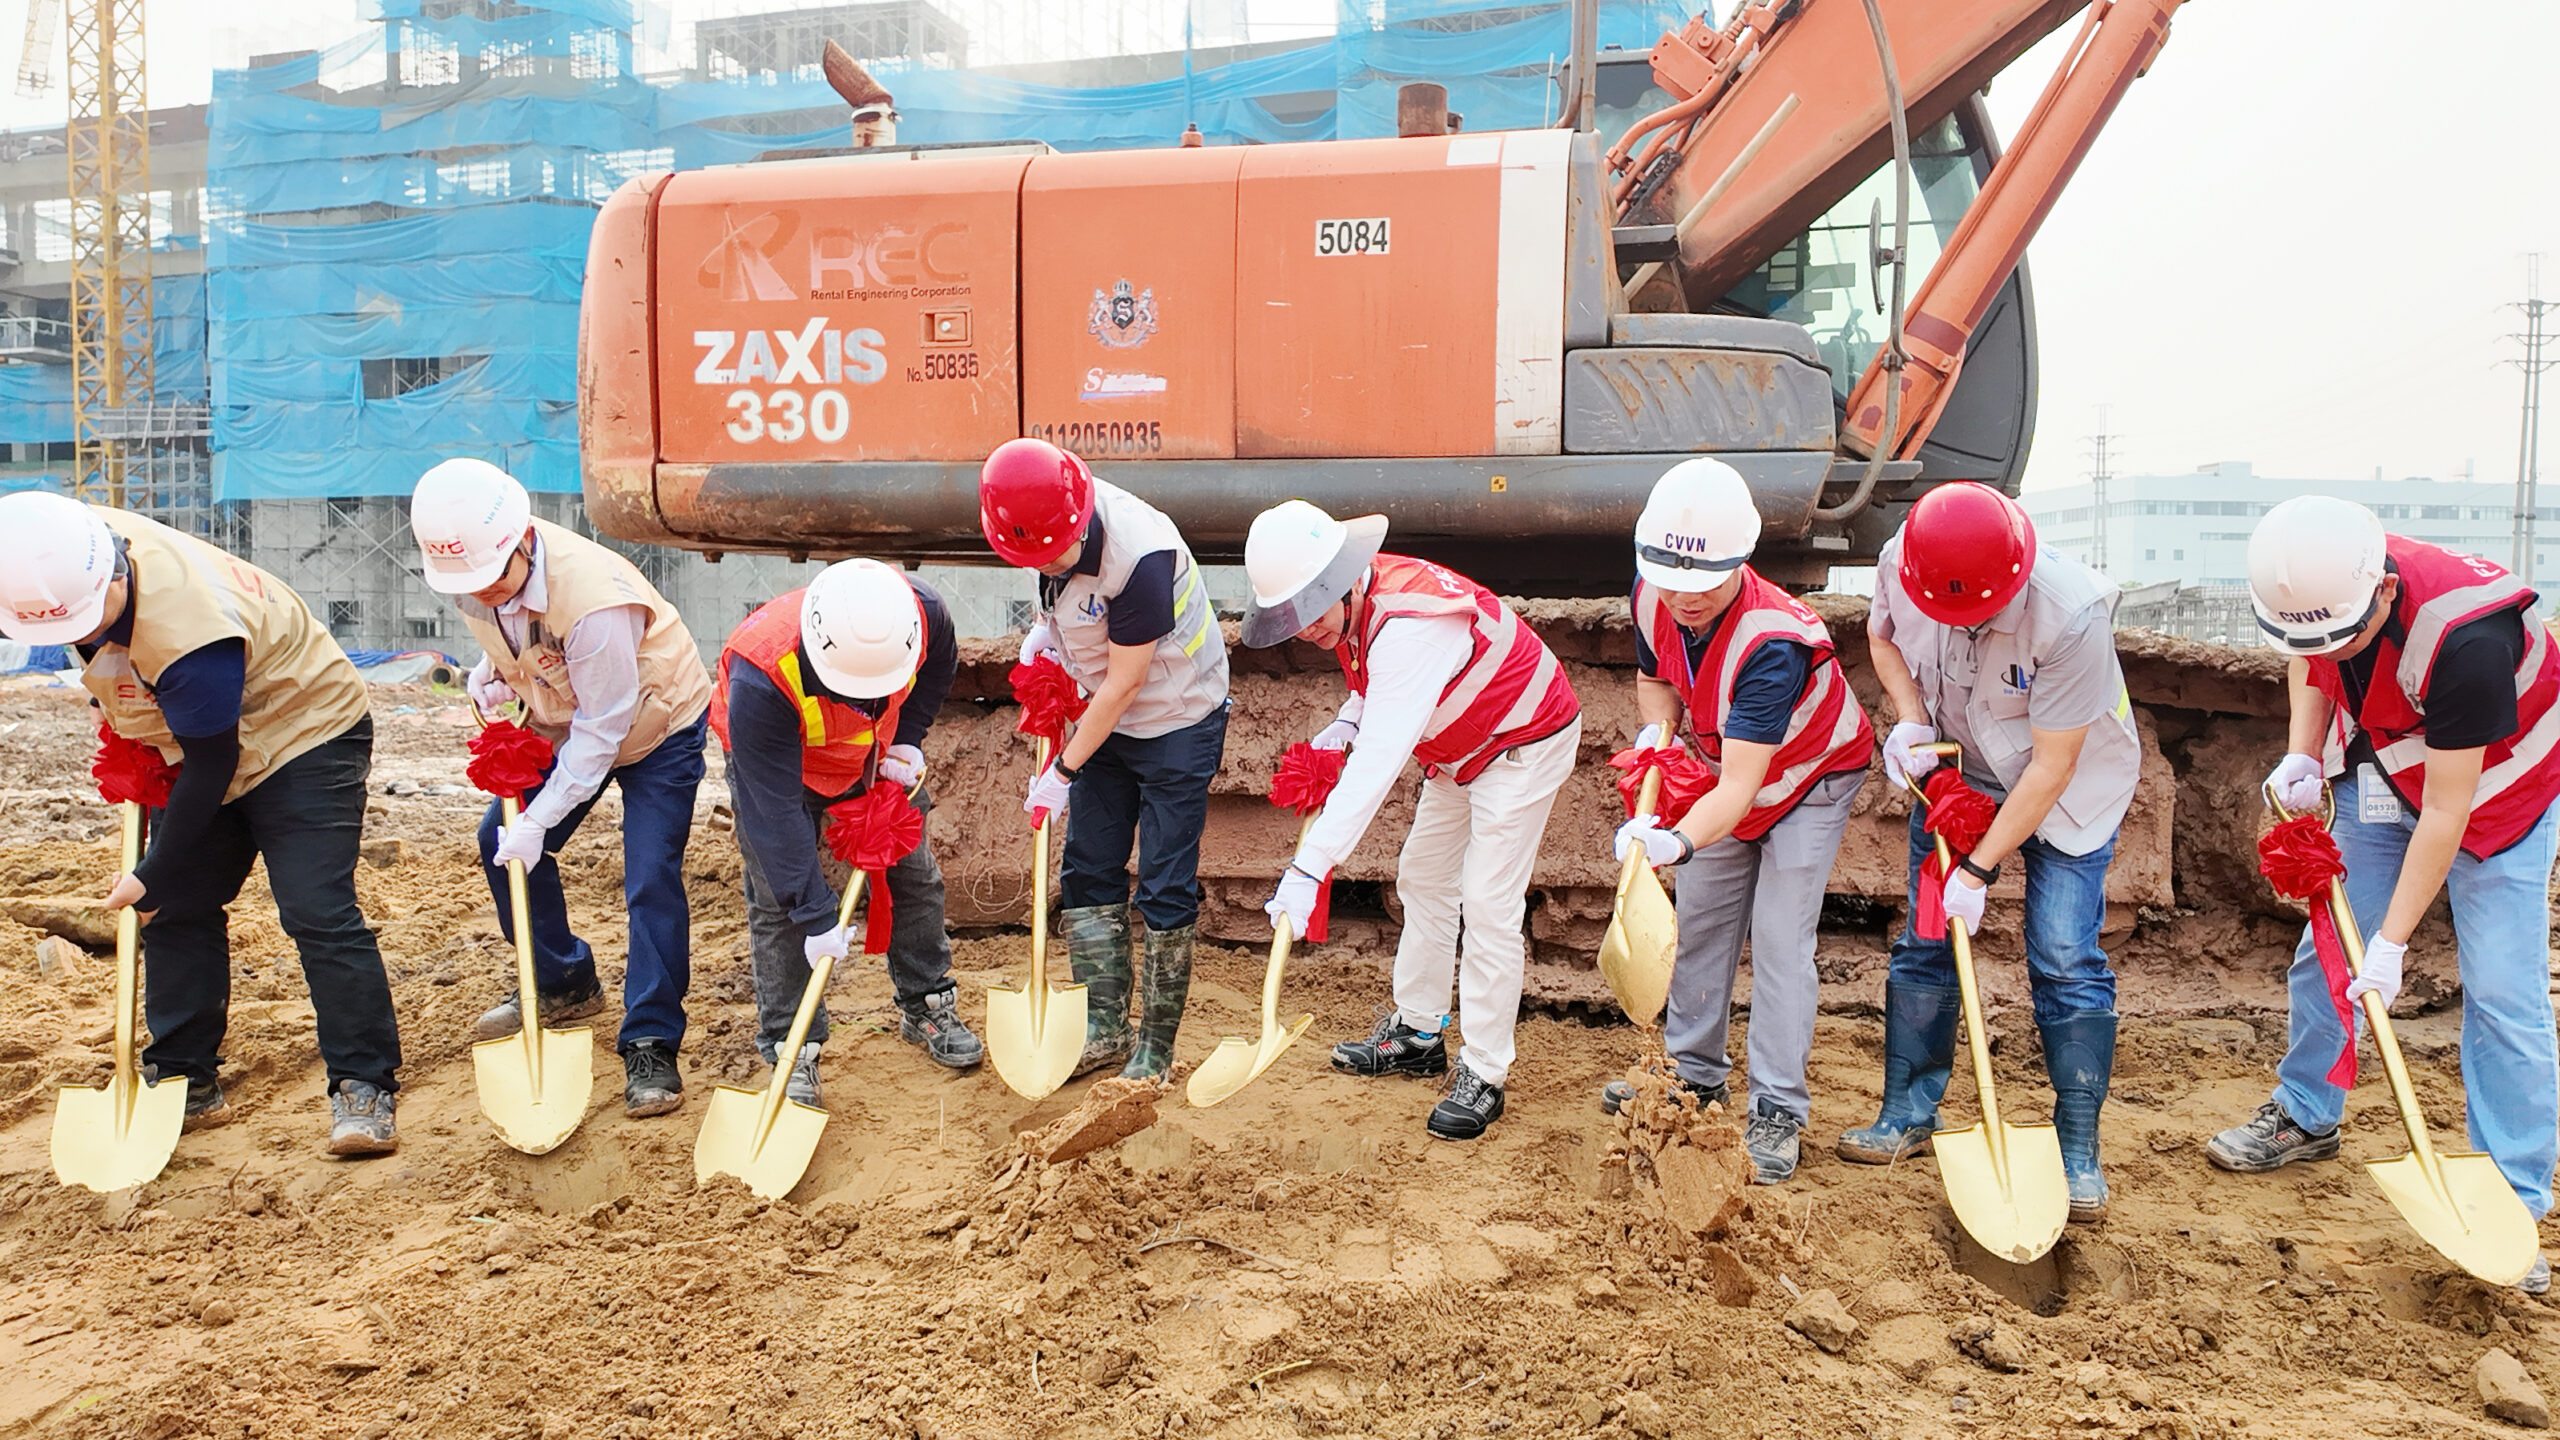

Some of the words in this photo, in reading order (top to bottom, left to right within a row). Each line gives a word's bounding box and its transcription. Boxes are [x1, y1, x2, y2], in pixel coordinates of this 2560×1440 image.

[1320, 220, 1388, 254] 5084
[811, 221, 970, 289] REC
[811, 289, 844, 300] Rental
[847, 287, 908, 301] Engineering
[911, 286, 971, 299] Corporation
[694, 317, 887, 384] ZAXIS
[906, 367, 923, 382] No.
[925, 353, 979, 379] 50835
[726, 389, 850, 443] 330
[1032, 421, 1161, 454] 0112050835
[1665, 532, 1706, 552] CVVN
[2279, 606, 2332, 623] CVVN
